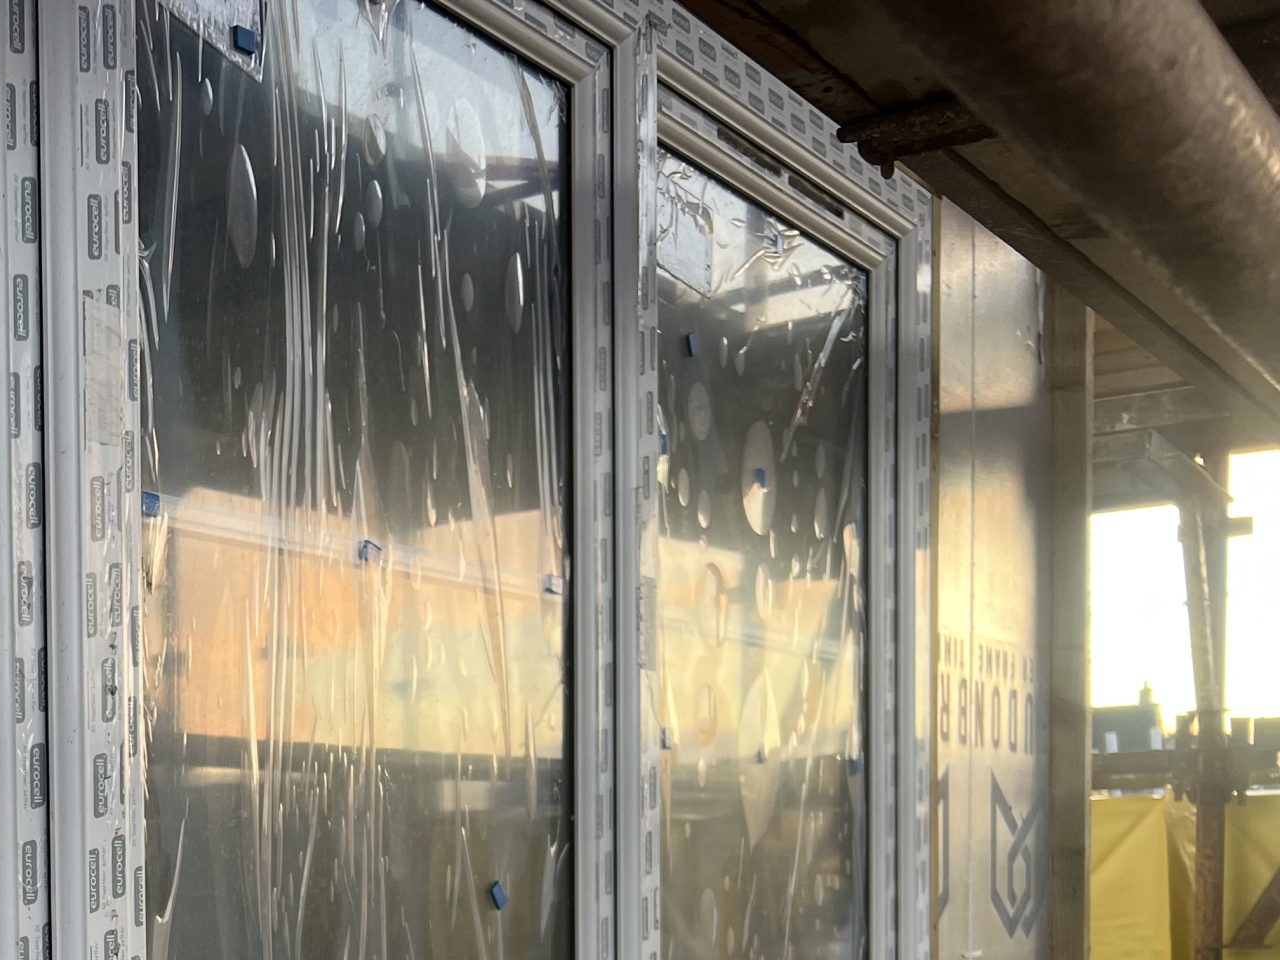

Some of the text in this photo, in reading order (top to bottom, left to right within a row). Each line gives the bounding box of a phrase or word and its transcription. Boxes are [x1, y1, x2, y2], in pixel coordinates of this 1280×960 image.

[80, 9, 88, 69] eurocell
[104, 8, 115, 66] eurocell
[98, 102, 107, 160] eurocell
[24, 181, 34, 239] eurocell
[90, 198, 100, 256] eurocell
[16, 278, 26, 337] eurocell
[29, 466, 38, 524] eurocell
[93, 481, 102, 537] eurocell
[85, 578, 94, 634] eurocell
[33, 747, 43, 803] eurocell
[96, 759, 106, 813] eurocell
[25, 844, 35, 900] eurocell
[88, 854, 98, 909] eurocell
[114, 839, 123, 894] eurocell
